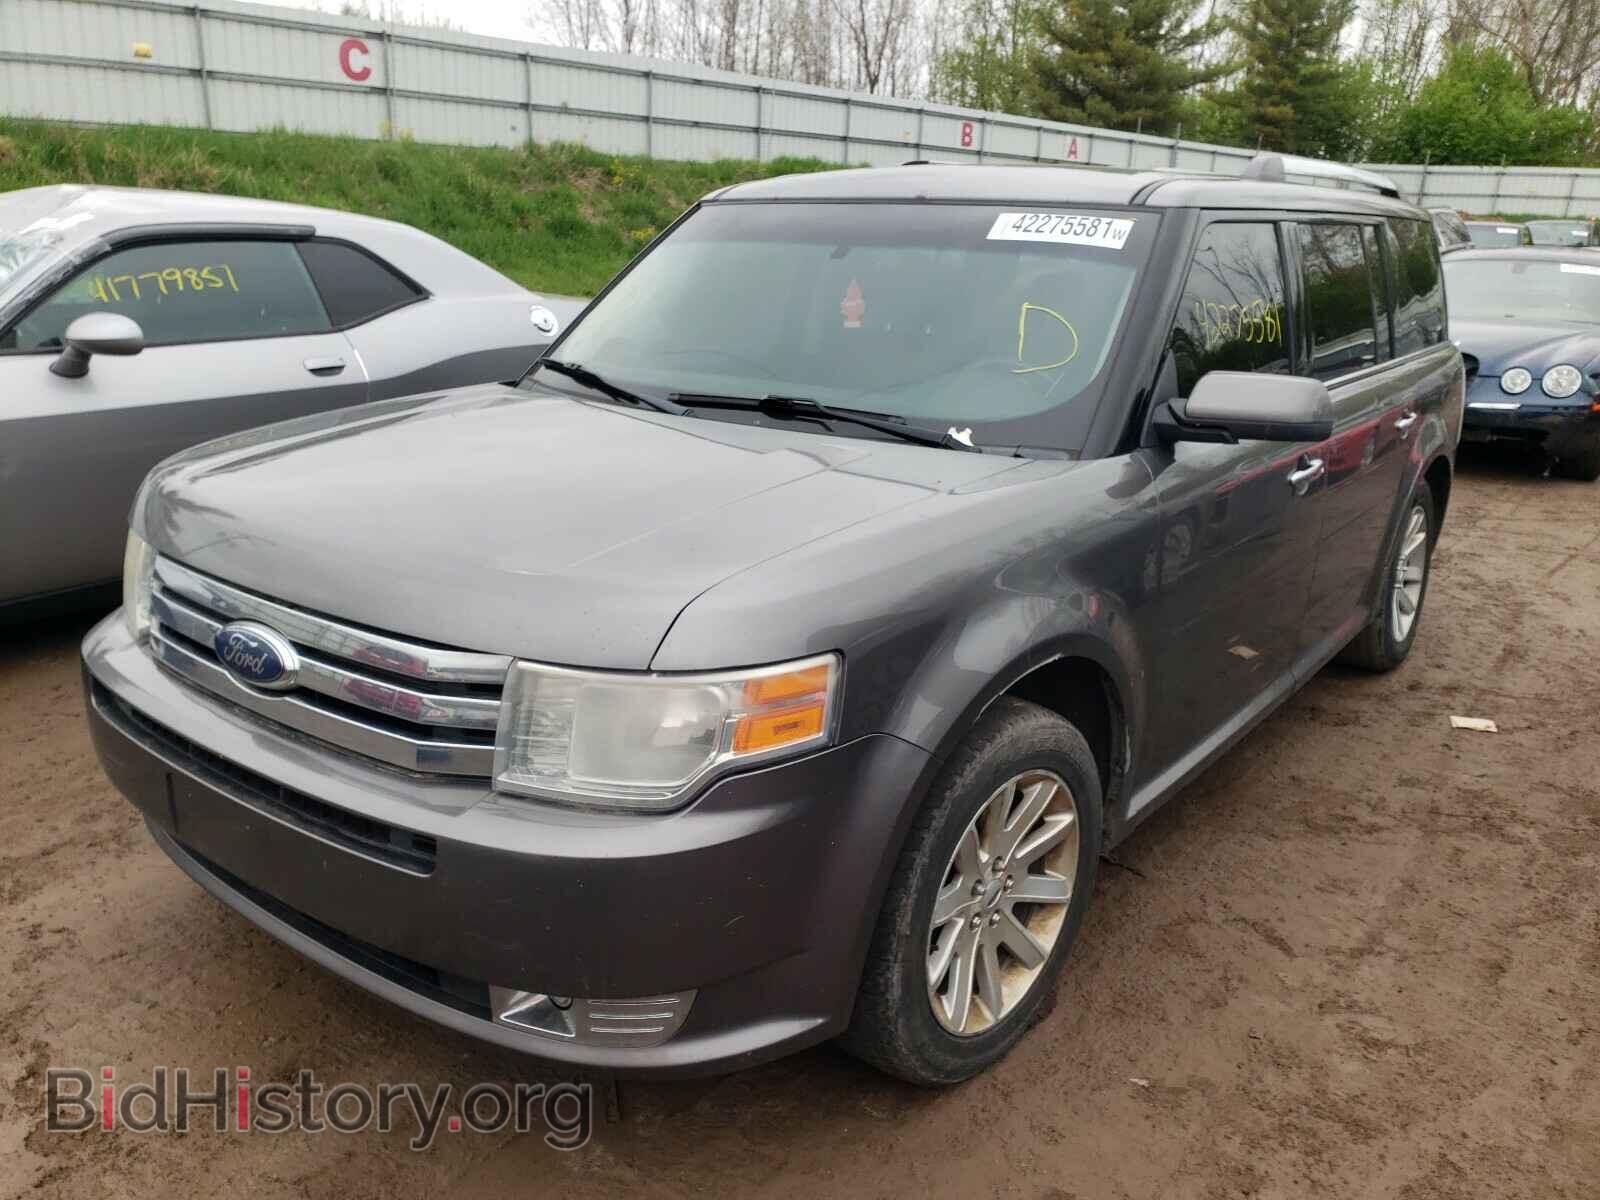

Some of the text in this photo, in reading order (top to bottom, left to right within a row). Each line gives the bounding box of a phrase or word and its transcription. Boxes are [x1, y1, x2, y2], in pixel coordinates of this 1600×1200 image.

[339, 38, 371, 81] C
[960, 121, 974, 148] B
[1066, 136, 1079, 160] A
[1010, 302, 1079, 374] D
[224, 632, 270, 675] Ford
